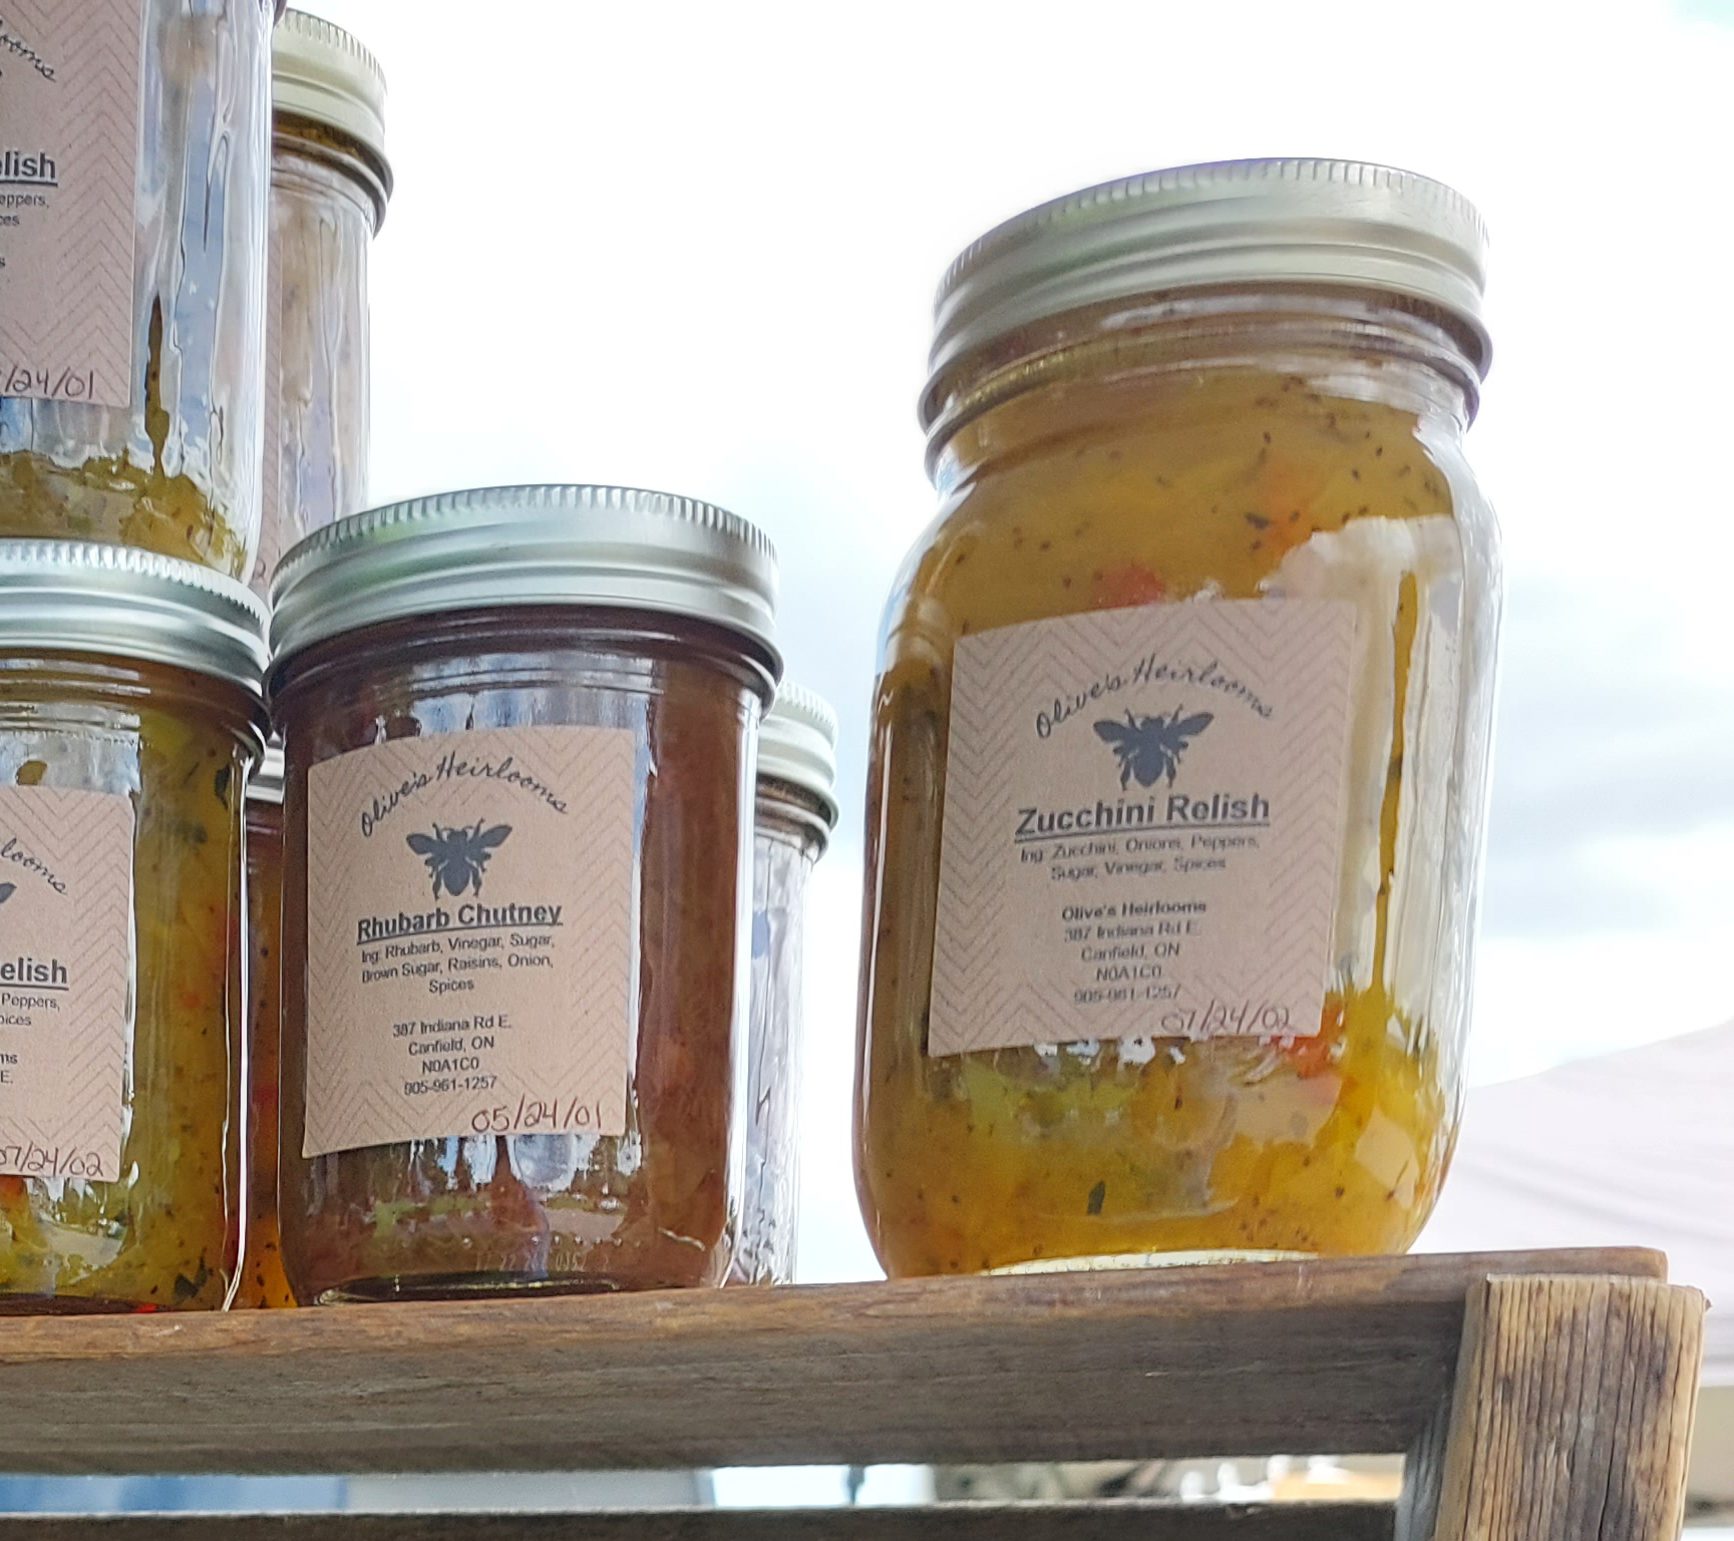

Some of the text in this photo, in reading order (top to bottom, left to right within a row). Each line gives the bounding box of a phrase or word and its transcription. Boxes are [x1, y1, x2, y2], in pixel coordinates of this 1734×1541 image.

[1133, 653, 1273, 720] Heirlooms
[436, 751, 568, 816] Heirlooms
[1015, 793, 1270, 835] Zucchini Relish
[358, 905, 563, 943] Rhubarb Chutney
[471, 1036, 494, 1049] ON
[471, 1094, 601, 1133] 05/24/01
